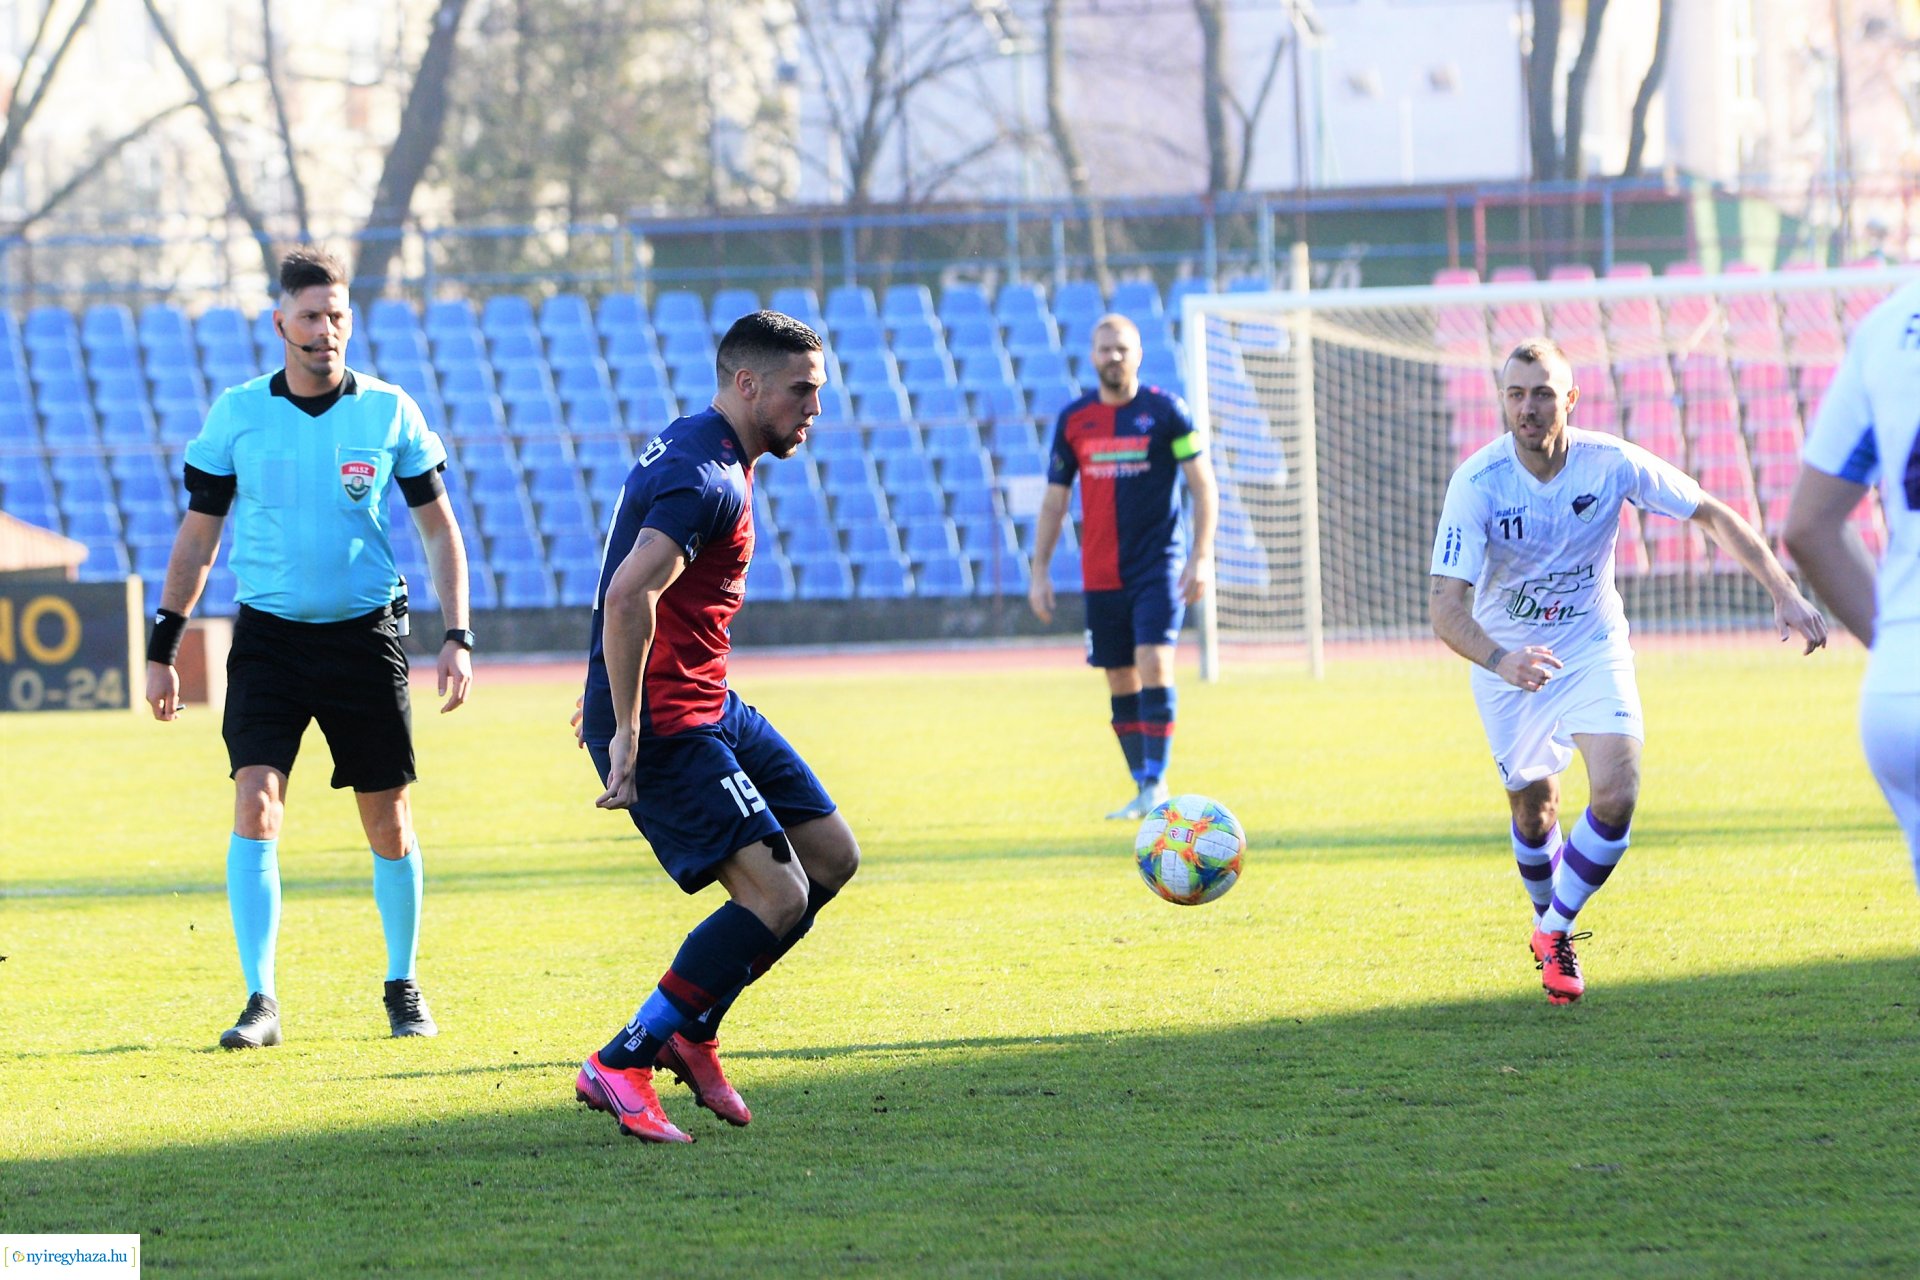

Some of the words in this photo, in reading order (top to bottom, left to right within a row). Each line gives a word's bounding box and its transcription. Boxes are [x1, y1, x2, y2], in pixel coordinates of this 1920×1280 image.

[1499, 515, 1523, 540] 11
[1506, 595, 1589, 621] Drén
[10, 668, 122, 709] 0-24
[720, 770, 766, 818] 19
